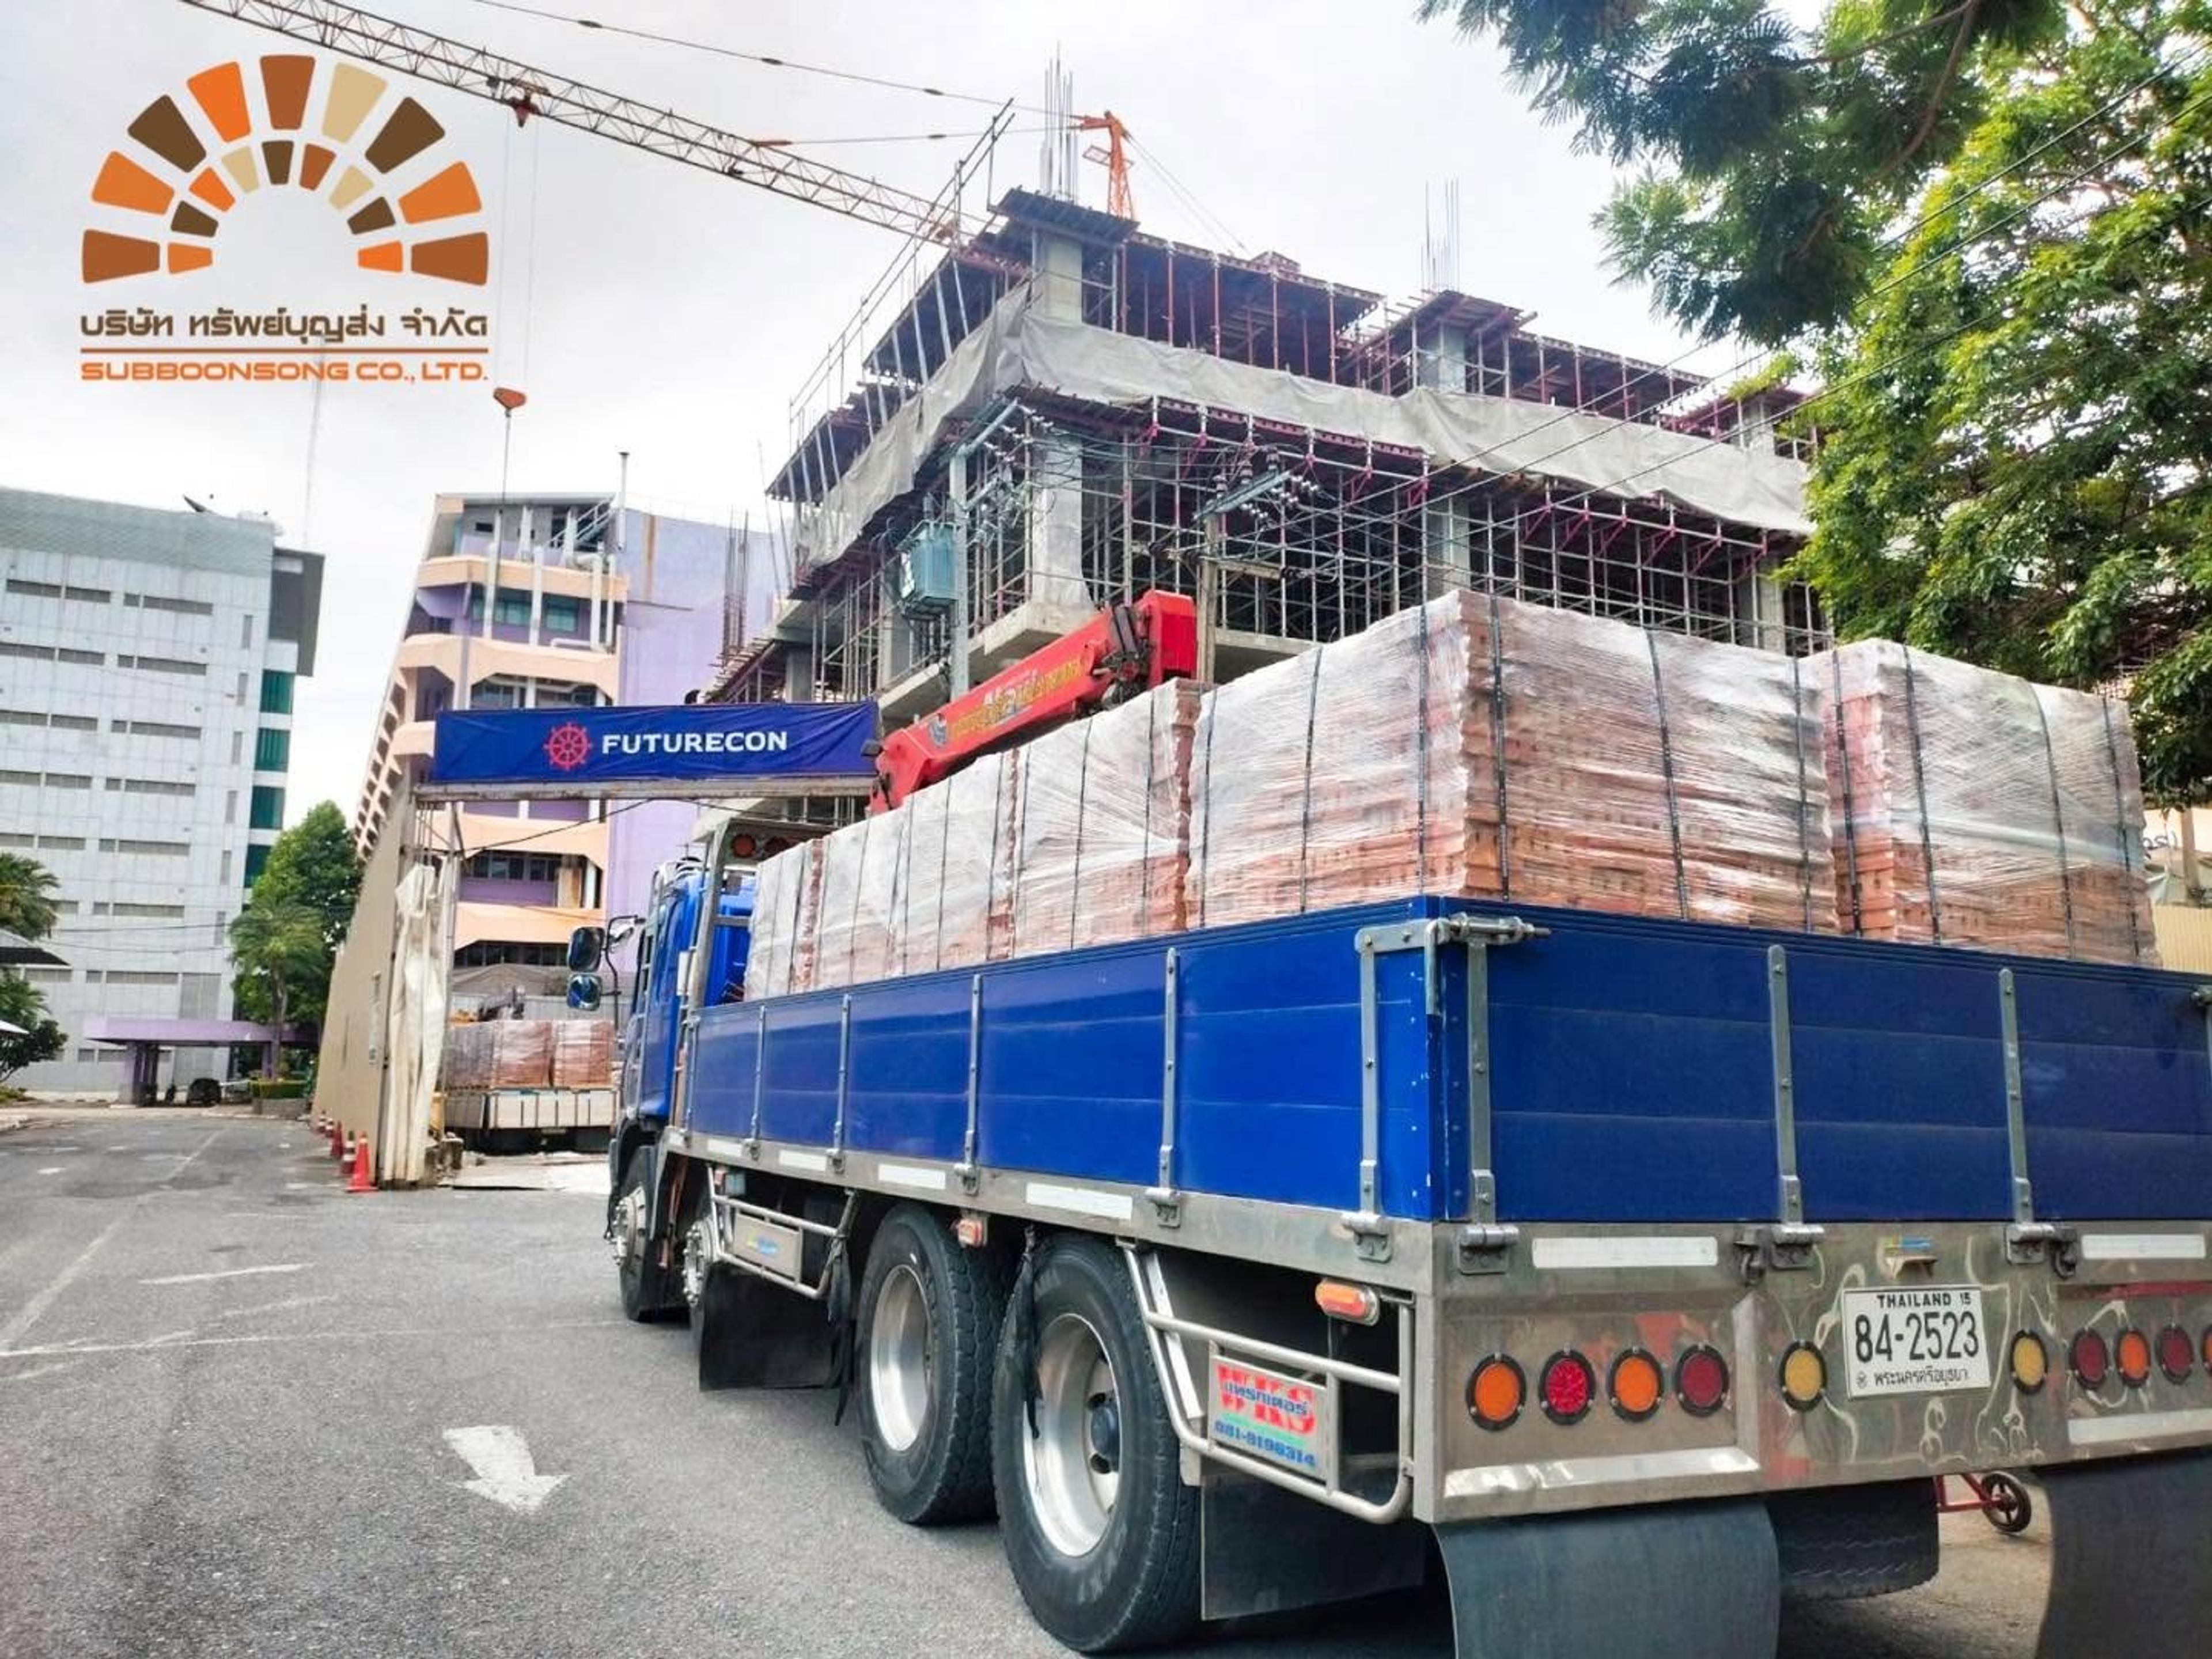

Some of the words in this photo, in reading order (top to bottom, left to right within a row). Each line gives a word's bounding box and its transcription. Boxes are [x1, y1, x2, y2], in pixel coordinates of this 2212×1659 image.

[601, 731, 787, 755] FUTURECON
[1876, 1292, 1952, 1308] THAILAND
[1855, 1310, 1979, 1363] 84-2523
